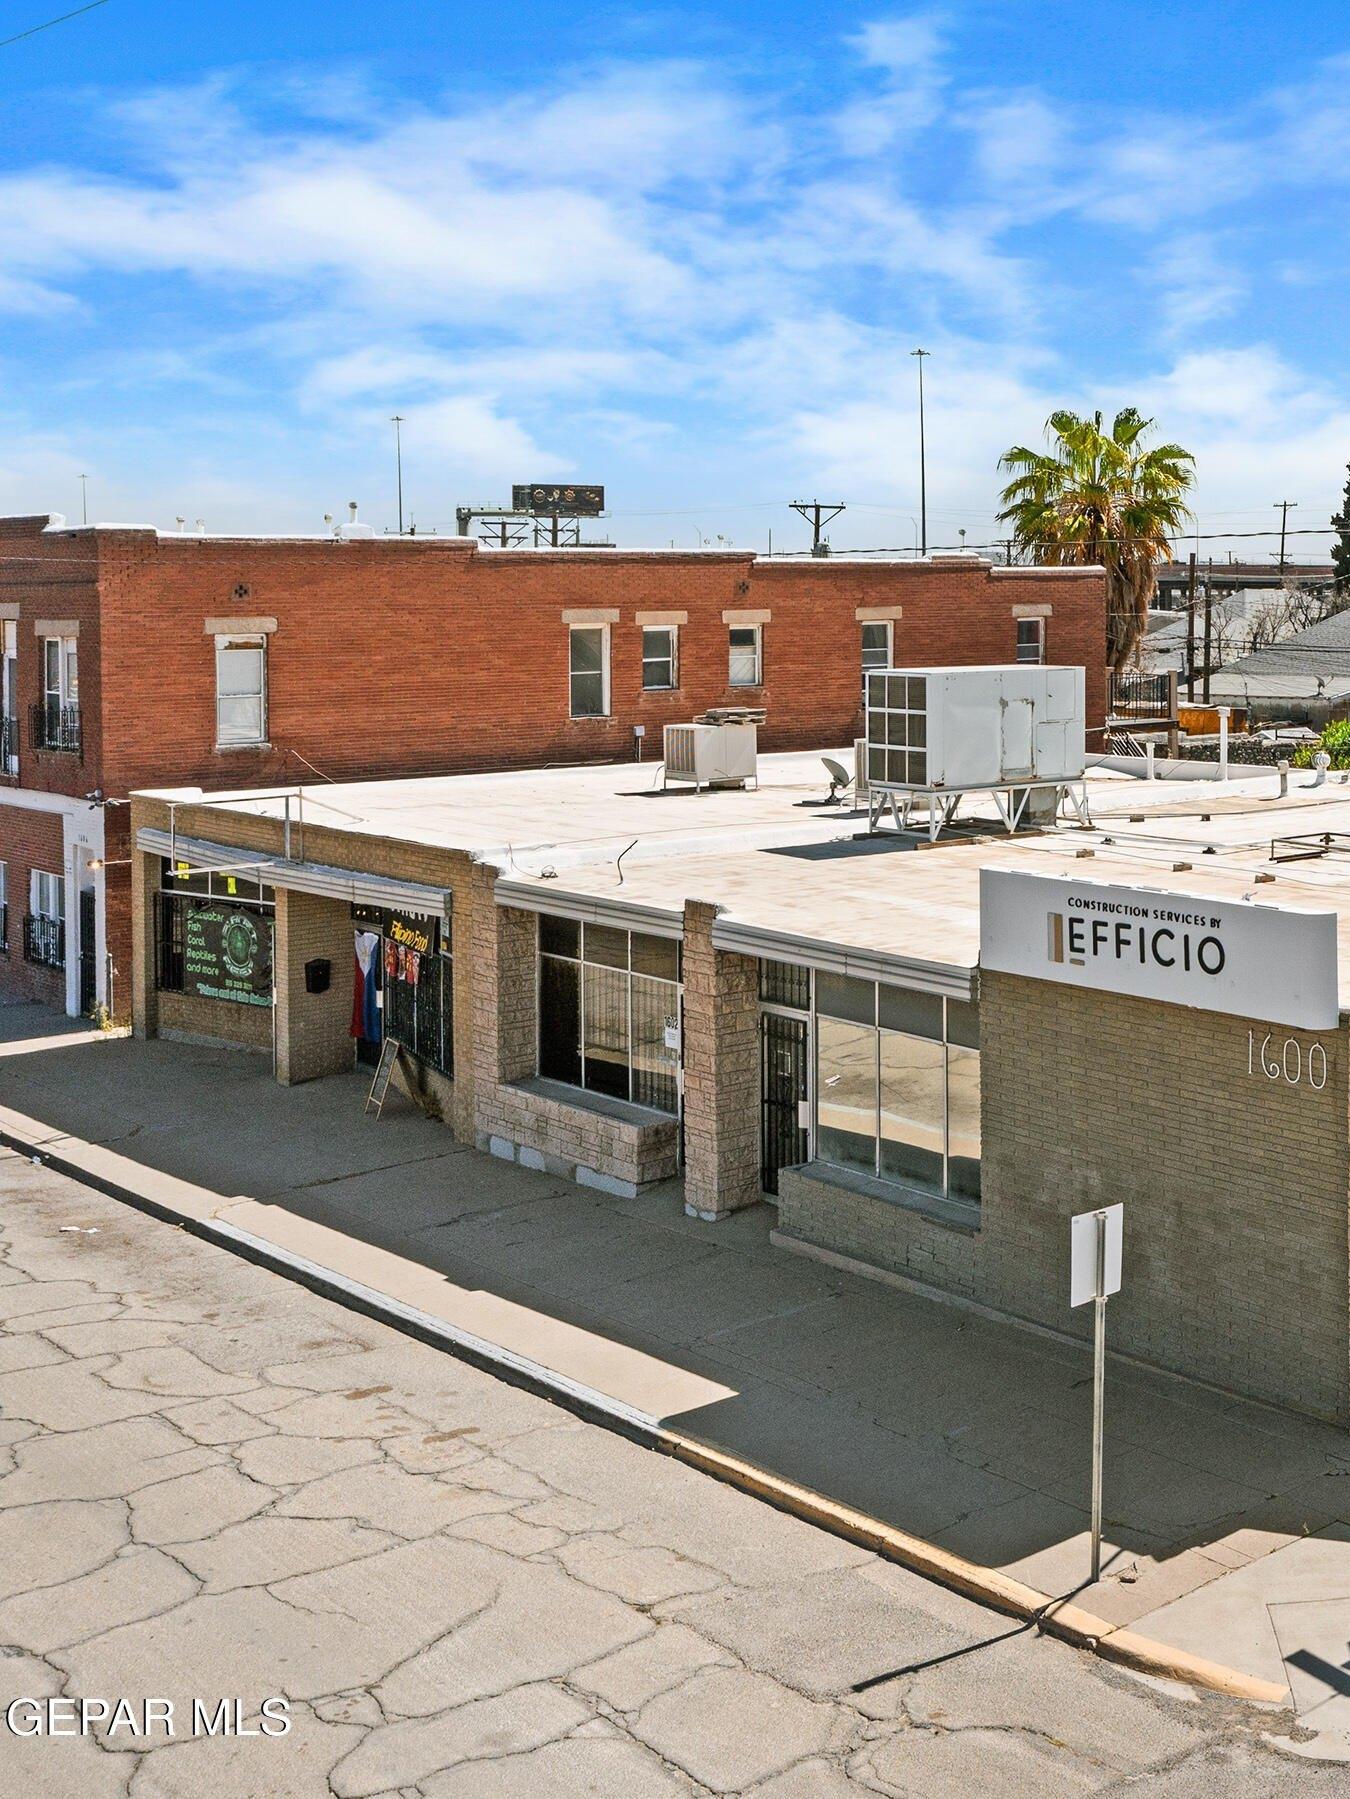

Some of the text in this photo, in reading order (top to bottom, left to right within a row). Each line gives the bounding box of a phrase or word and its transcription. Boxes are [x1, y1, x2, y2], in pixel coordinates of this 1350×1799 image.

[1067, 897, 1222, 929] CONSTRUCTION SERVICES BY
[187, 920, 202, 932] Fish
[187, 934, 206, 946] Coral
[1068, 917, 1226, 975] EFFICIO
[186, 947, 217, 962] Reptiles
[186, 963, 201, 973] and
[201, 966, 219, 976] more
[1248, 1029, 1327, 1089] 1600
